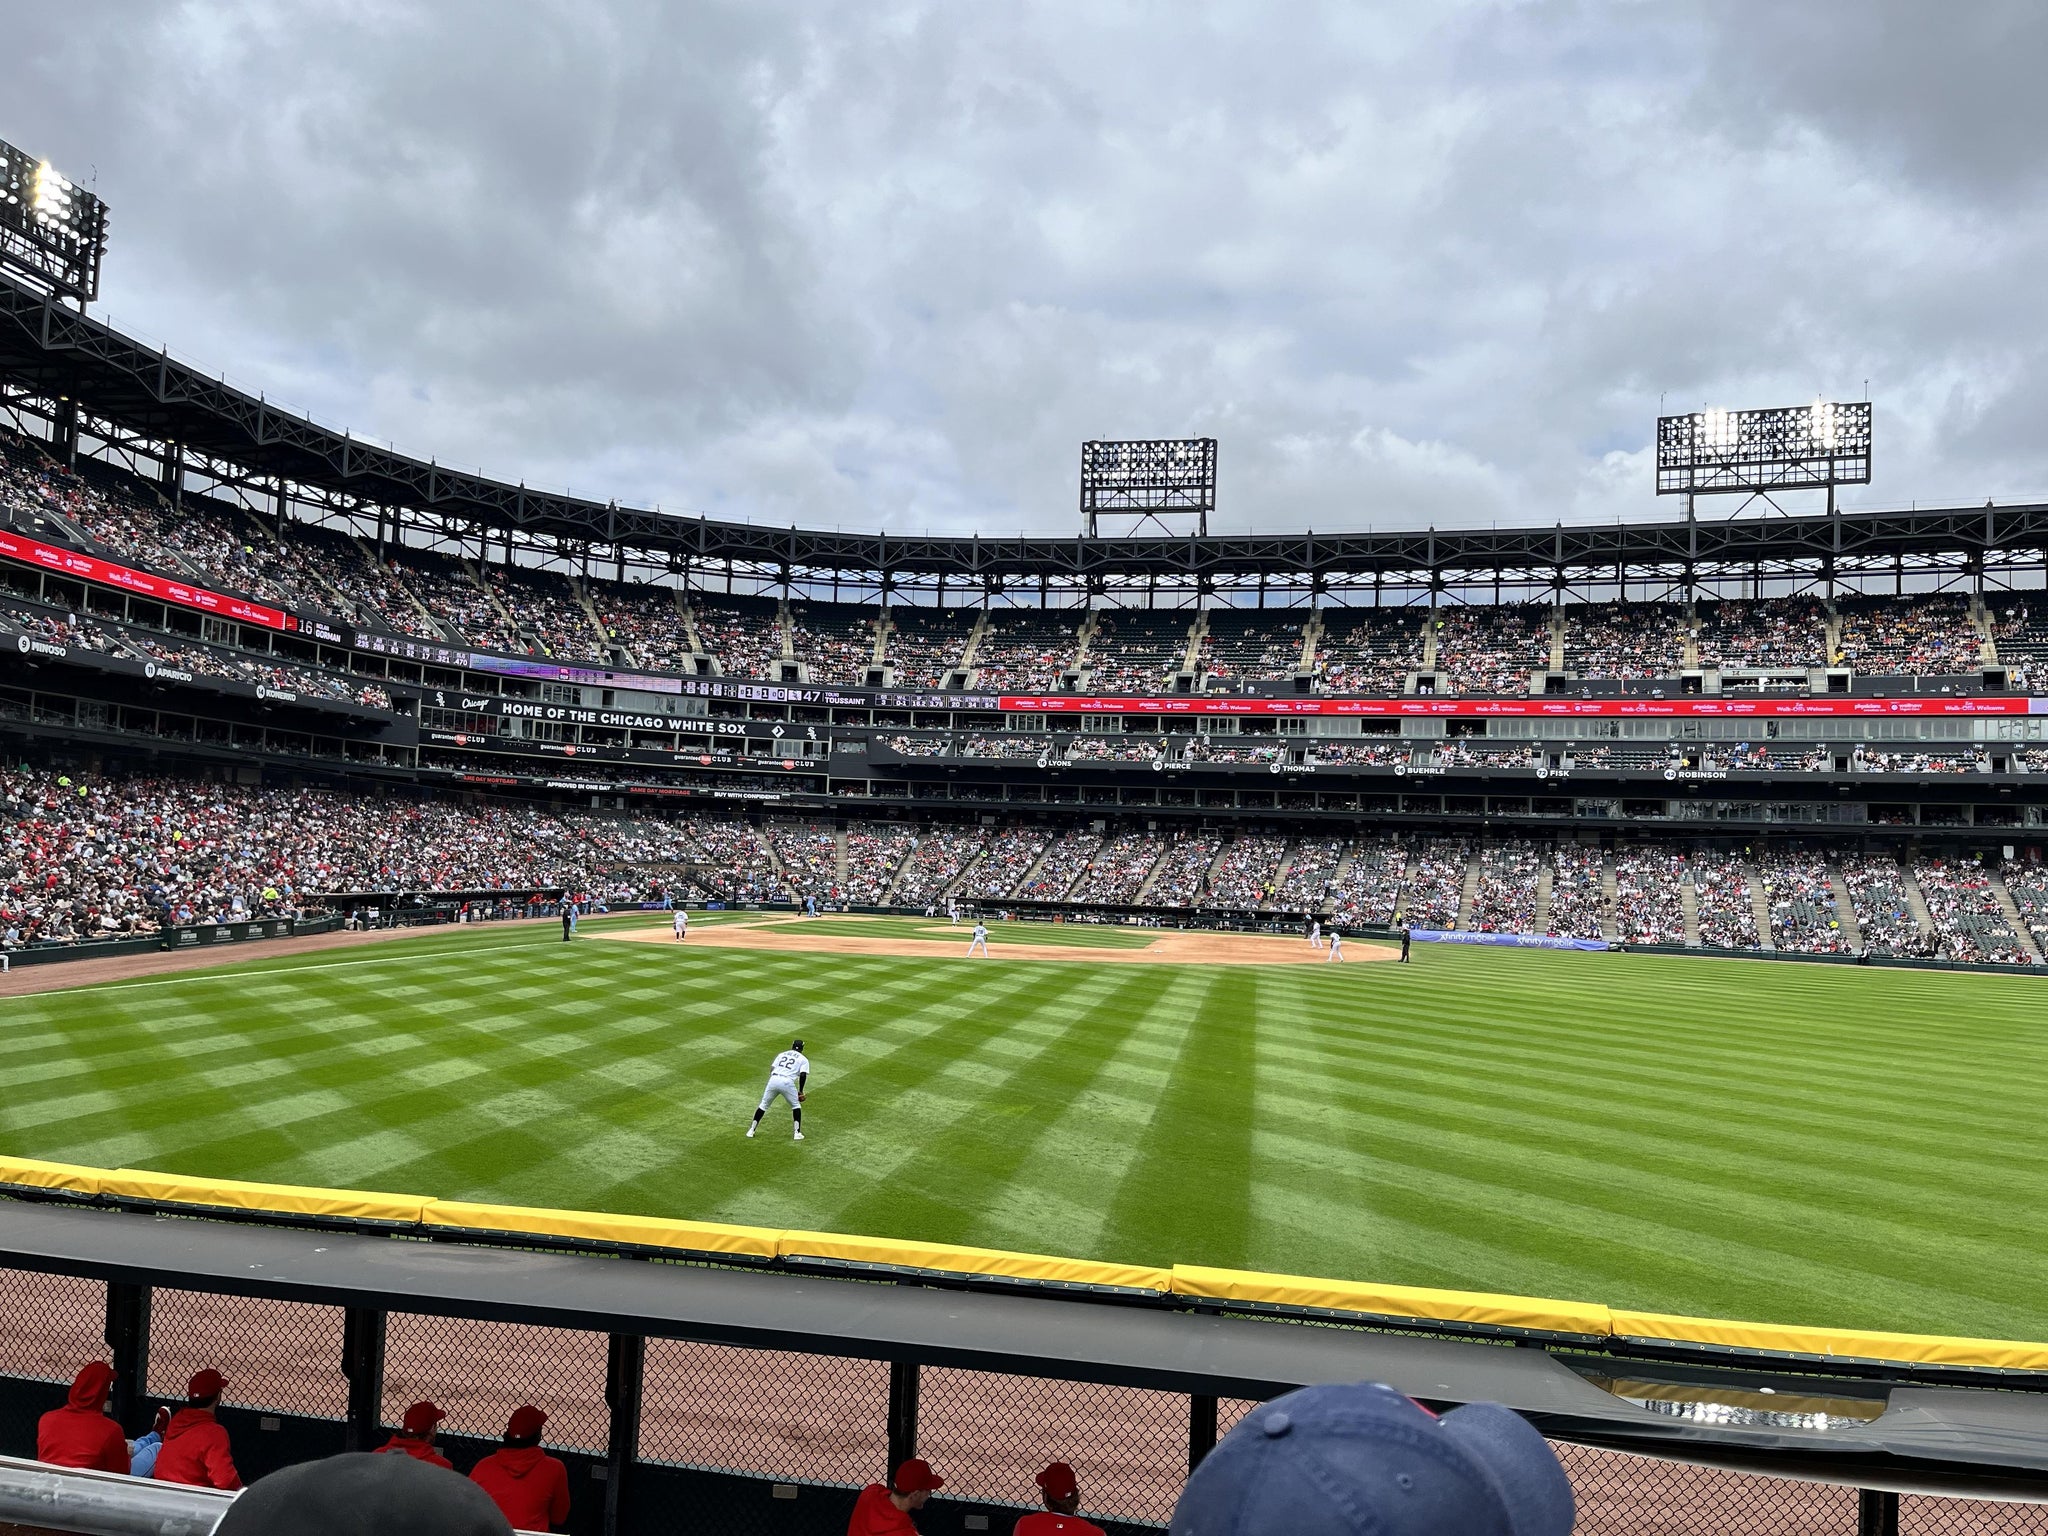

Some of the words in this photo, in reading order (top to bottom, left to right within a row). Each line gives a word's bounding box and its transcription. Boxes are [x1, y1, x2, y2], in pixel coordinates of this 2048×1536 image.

[299, 619, 313, 635] 16
[316, 630, 340, 642] GORMAN
[156, 668, 192, 682] APARICIO
[266, 690, 296, 701] KONERKO
[803, 691, 820, 702] 47
[825, 697, 865, 705] TOUSSAINT
[462, 698, 489, 711] Chicago
[503, 703, 542, 717] HOME
[547, 707, 565, 718] OF
[569, 710, 596, 722] THE
[601, 713, 663, 729] CHICAGO
[669, 719, 714, 732] WHITE
[719, 723, 746, 735] SOX
[487, 777, 518, 785] MORTGAGE
[547, 781, 576, 789] APPROVED
[1440, 934, 1466, 942] xfinity
[1467, 934, 1496, 942] mobile
[1517, 937, 1543, 946] xfinity
[1544, 939, 1574, 947] mobile
[779, 1056, 795, 1070] 22
